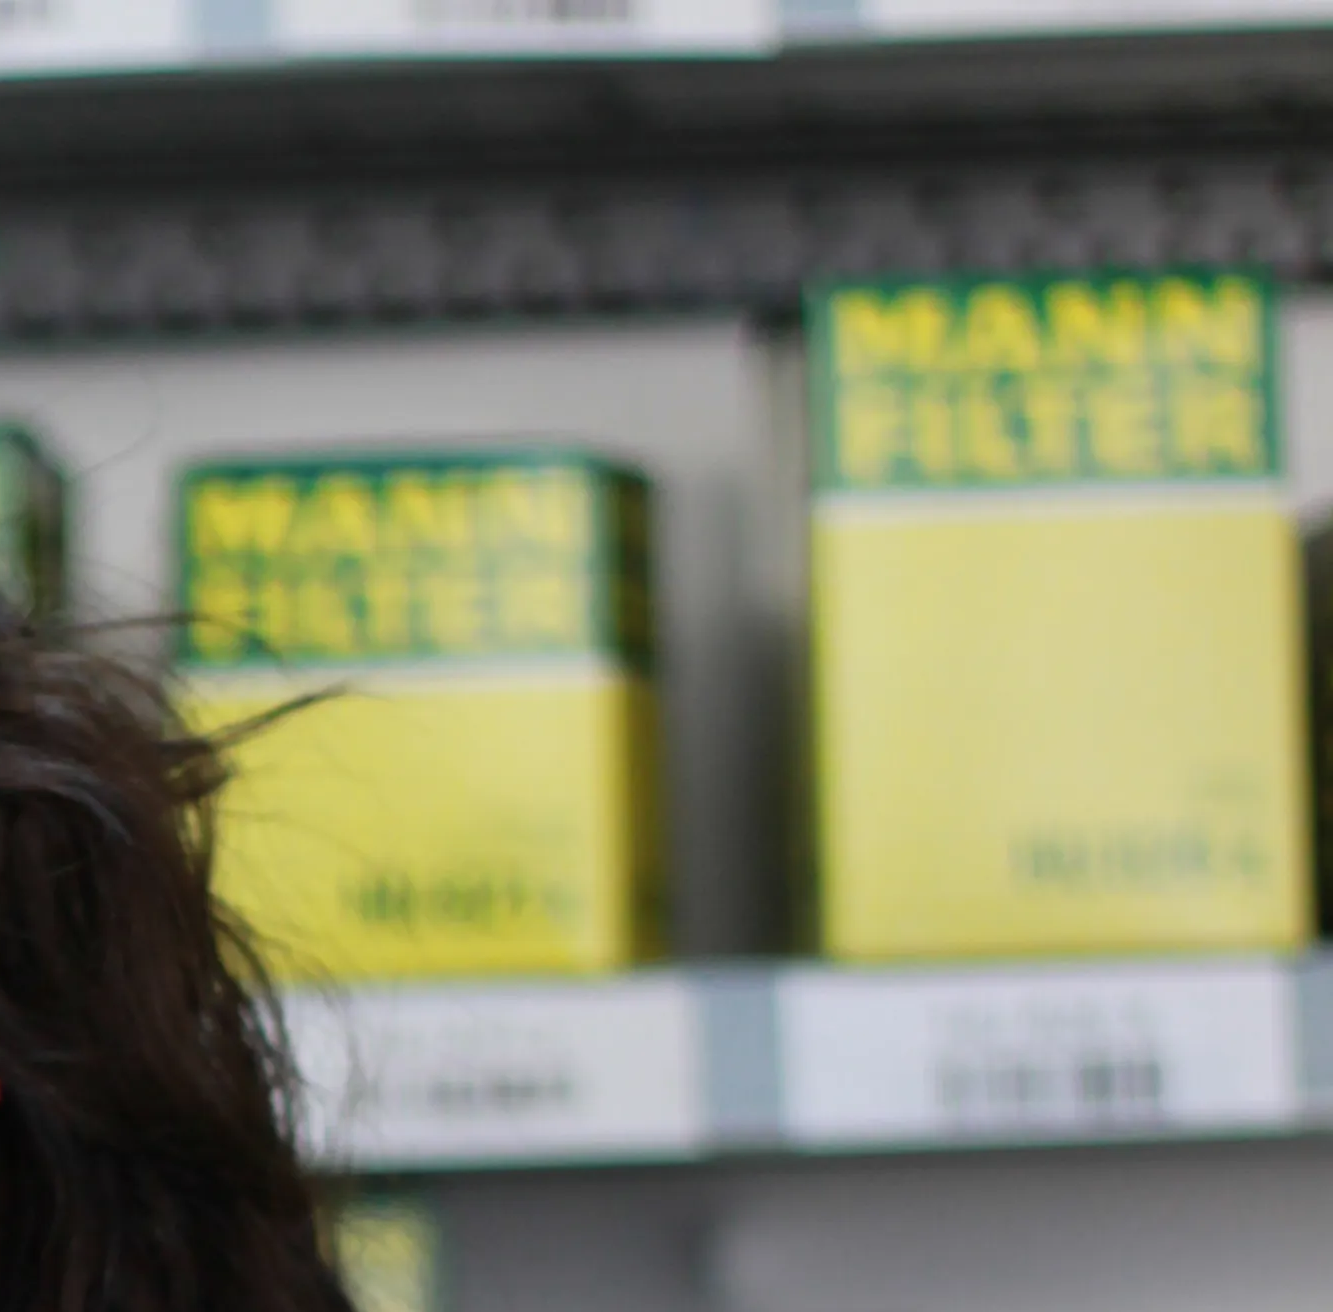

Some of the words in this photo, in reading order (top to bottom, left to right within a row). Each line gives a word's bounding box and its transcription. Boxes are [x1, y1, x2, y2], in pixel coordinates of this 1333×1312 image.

[826, 275, 1263, 375] MANN
[833, 378, 1264, 484] FILTER
[191, 468, 589, 555] MANN
[191, 567, 587, 656] FILTER
